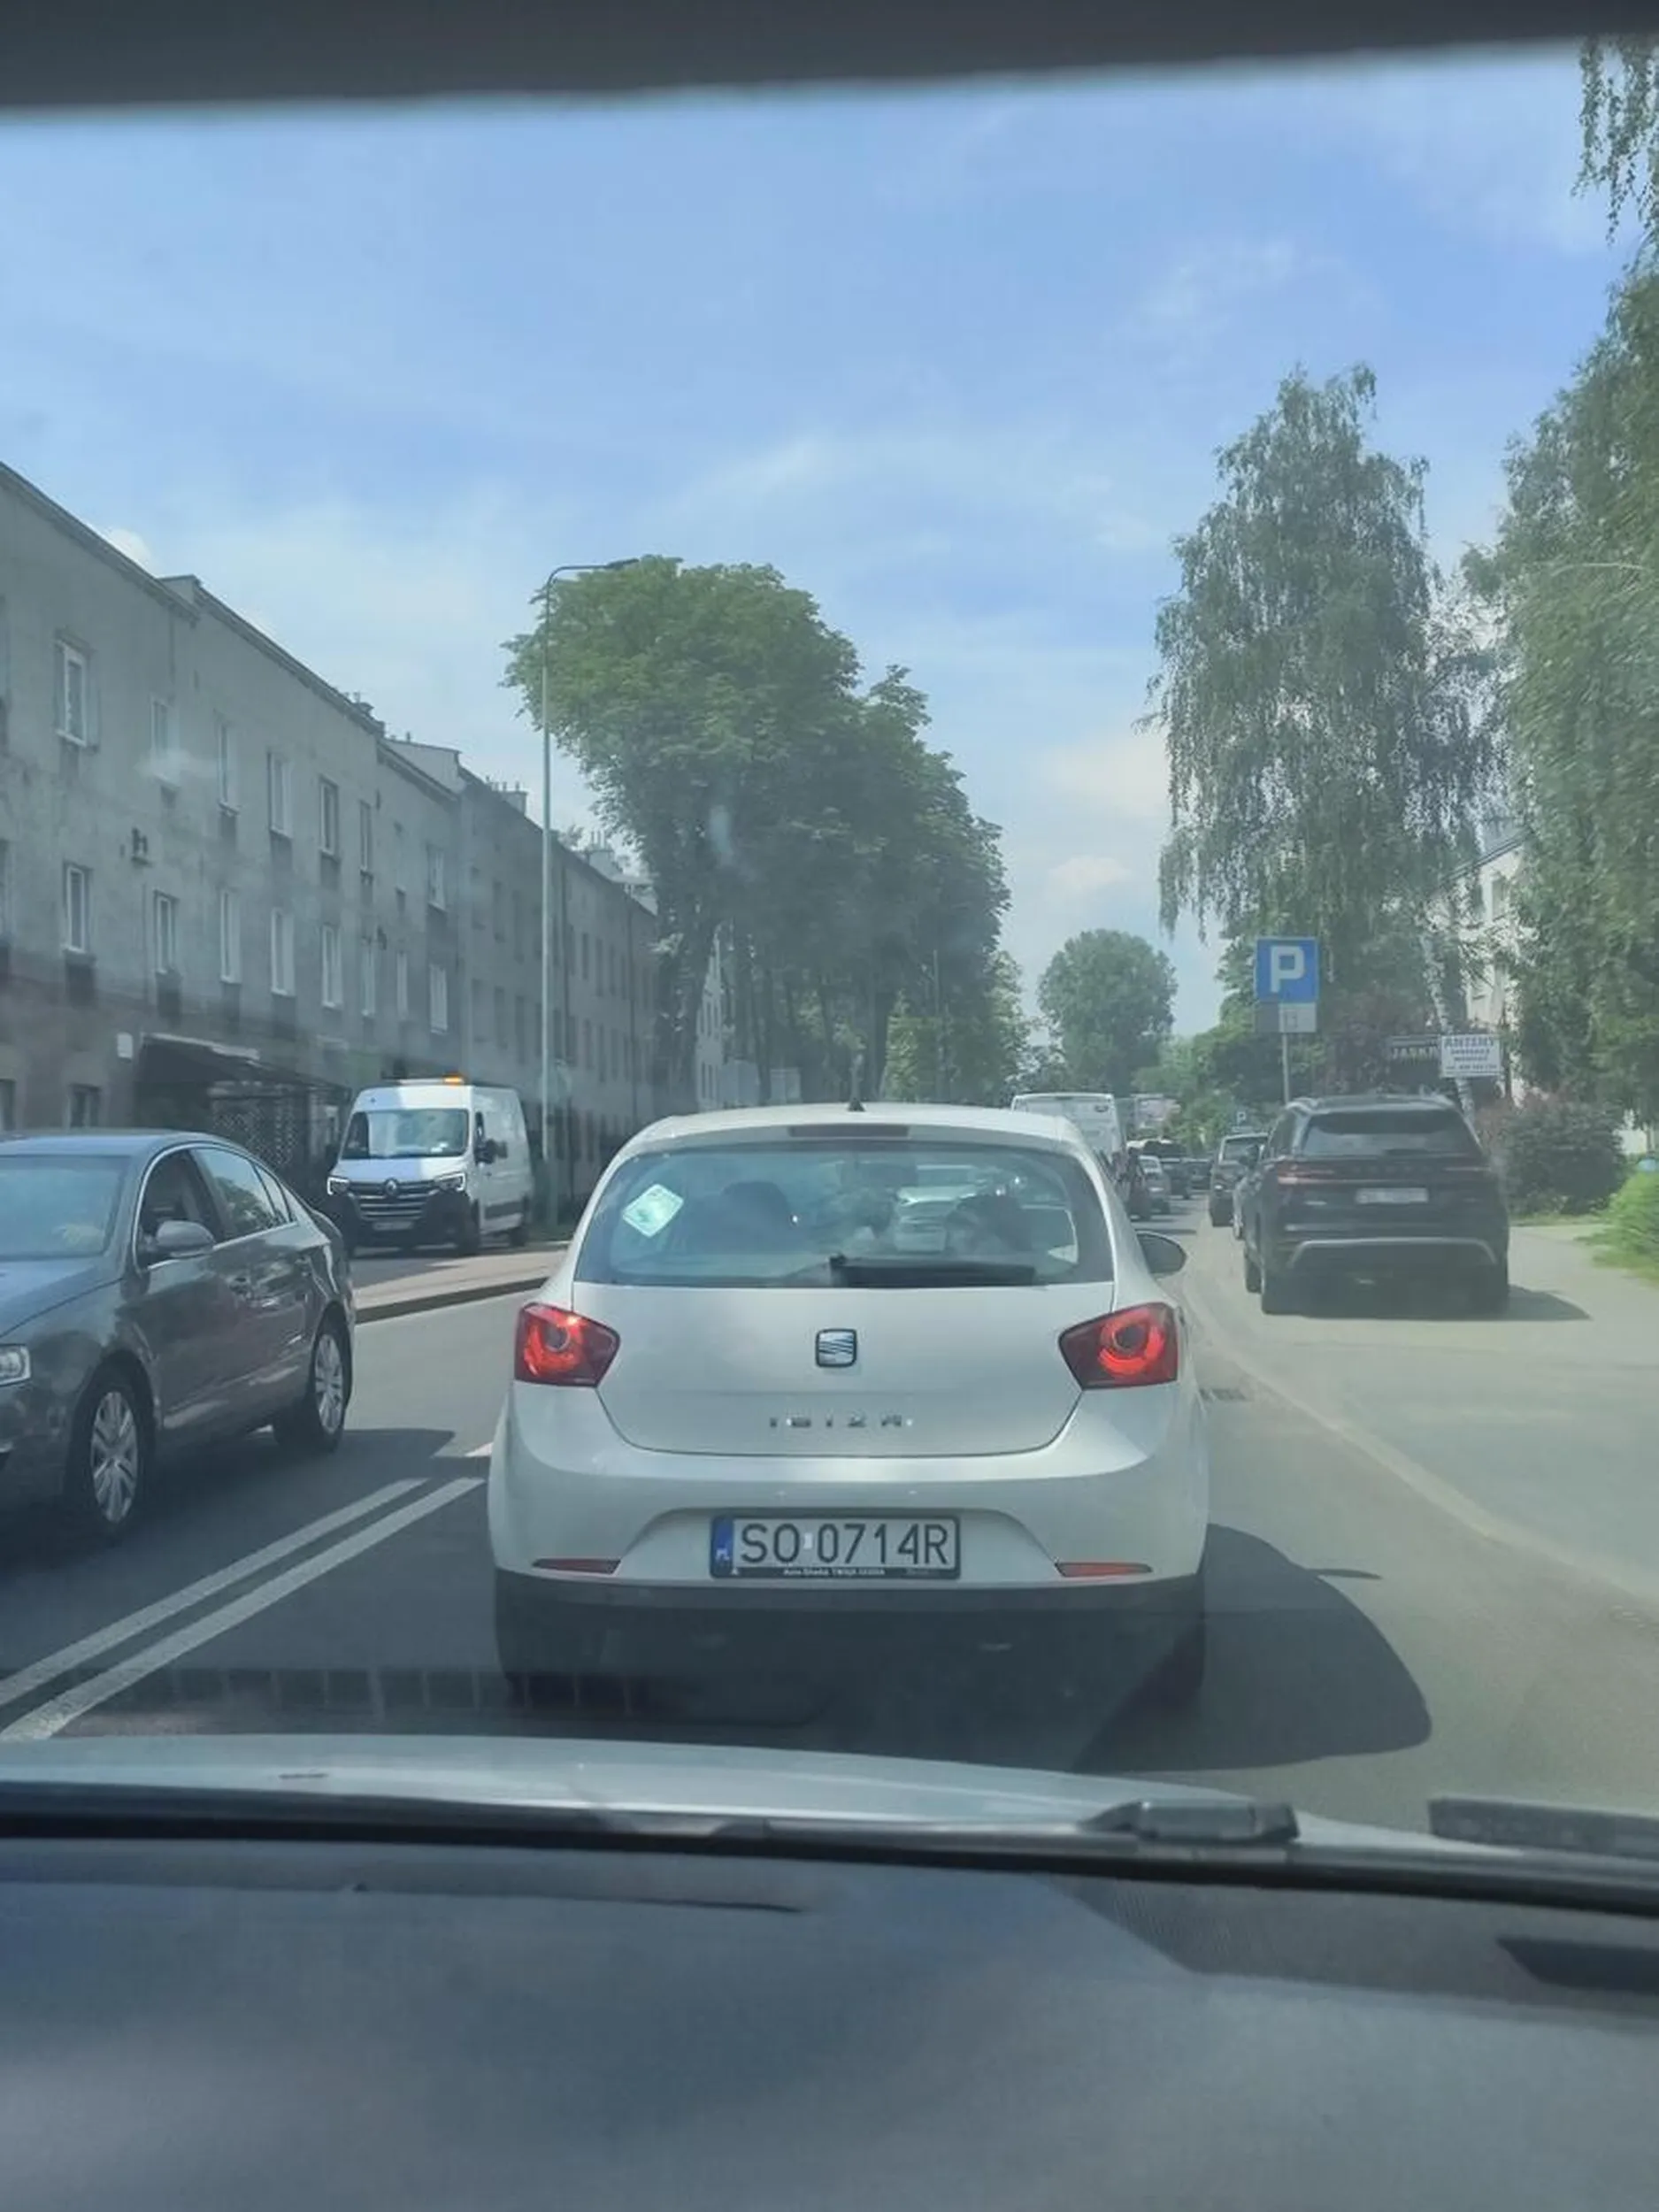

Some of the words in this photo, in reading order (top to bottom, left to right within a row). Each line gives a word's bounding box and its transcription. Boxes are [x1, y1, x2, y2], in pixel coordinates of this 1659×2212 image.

[1270, 945, 1305, 993] P
[741, 1522, 800, 1564] SO
[818, 1522, 949, 1565] 0714R
